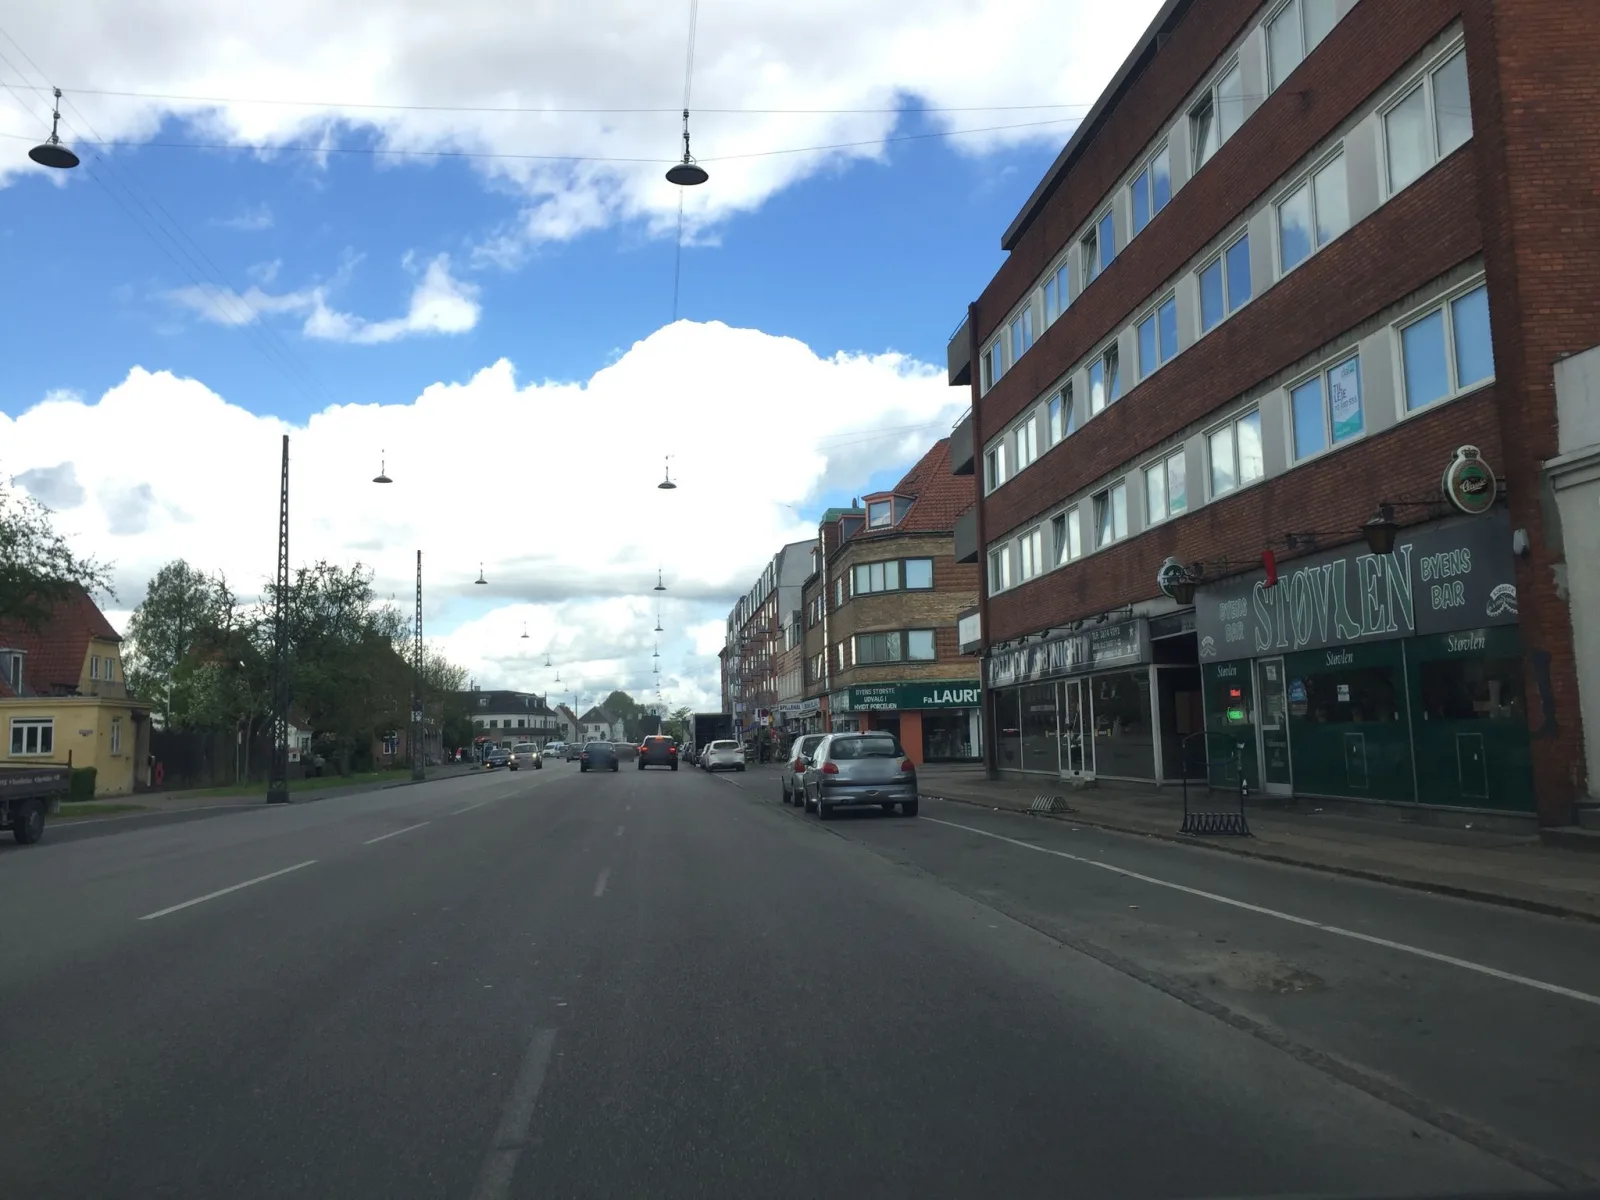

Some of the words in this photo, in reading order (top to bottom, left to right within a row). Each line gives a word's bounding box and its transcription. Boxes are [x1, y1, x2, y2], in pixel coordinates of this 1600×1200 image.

[1333, 383, 1343, 394] TIL
[1334, 389, 1347, 403] LEJE
[1420, 547, 1472, 582] BYENS
[1252, 543, 1415, 652] STØVLEN
[1431, 580, 1466, 610] BAR
[1219, 597, 1248, 622] BYENS
[1224, 621, 1245, 643] BAR
[1447, 633, 1485, 653] Støvlen
[1325, 648, 1354, 667] Støvlen
[863, 695, 884, 703] UDVALG
[933, 688, 981, 704] LAURI
